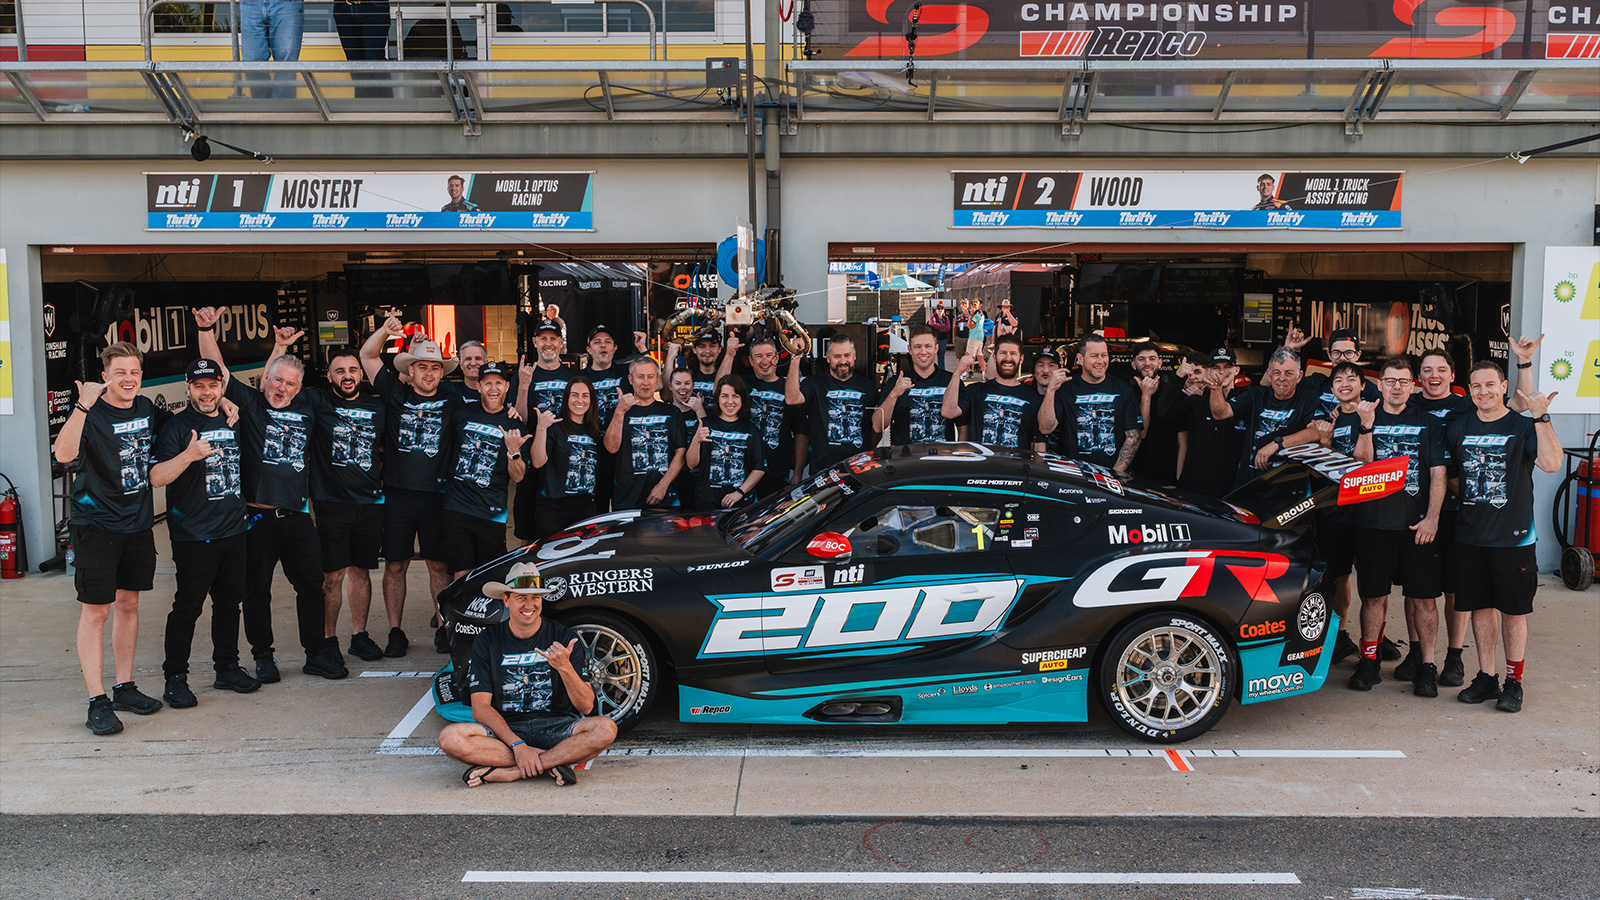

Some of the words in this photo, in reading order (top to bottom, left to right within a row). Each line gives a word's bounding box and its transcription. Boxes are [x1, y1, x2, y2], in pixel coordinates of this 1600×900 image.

[1021, 3, 1297, 22] CHAMPIONSHIP
[1088, 26, 1207, 60] Repco
[495, 180, 522, 192] MOBIL
[524, 180, 529, 192] 1
[532, 180, 559, 192] OPTUS
[961, 175, 1009, 202] nti
[1034, 176, 1055, 205] 2
[1089, 176, 1144, 206] WOOD
[1304, 178, 1331, 191] MOBIL
[1333, 178, 1339, 191] 1
[1341, 178, 1370, 191] TRUCK
[155, 178, 201, 204] nti
[232, 180, 244, 207] 1
[280, 179, 363, 208] MOSTERT
[512, 193, 542, 206] RACING
[1304, 191, 1336, 205] ASSIST
[1336, 191, 1368, 205] RACING
[167, 214, 203, 228] Thrifty
[240, 214, 276, 228] Thrifty
[313, 214, 350, 228] Thrifty
[386, 214, 422, 228] Thrifty
[460, 214, 496, 228] Thrifty
[533, 214, 569, 228] Thrifty
[972, 212, 1009, 226] Thrifty
[1046, 212, 1082, 226] Thrifty
[1120, 212, 1156, 226] Thrifty
[1194, 212, 1230, 226] Thrifty
[1268, 212, 1304, 226] Thrifty
[1341, 212, 1378, 226] Thrifty
[1568, 271, 1578, 280] bp
[1407, 330, 1450, 357] ASSIS
[1564, 349, 1575, 358] bp
[1343, 470, 1404, 488] SUPERCHEAP
[1361, 484, 1383, 493] AUTO
[971, 524, 985, 550] 1
[1107, 523, 1168, 545] Mobil
[825, 541, 846, 551] BOC
[695, 560, 750, 572] DUNLOP
[568, 568, 654, 585] RINGERS
[833, 564, 865, 583] nti
[1073, 549, 1290, 608] GR
[569, 579, 654, 598] WESTERN
[467, 597, 493, 613] NGK
[702, 579, 1026, 654] 200
[1239, 620, 1287, 639] Coates
[1169, 618, 1206, 637] SPORT
[1205, 633, 1229, 663] MAXX
[633, 643, 650, 680] SPORT
[1021, 646, 1087, 665] SUPERCHEAP
[1041, 661, 1065, 670] AUTO
[952, 684, 978, 693] Lloyds
[1248, 671, 1304, 693] move
[633, 680, 650, 714] MAXX
[917, 691, 941, 699] Spicers
[701, 705, 732, 715] Repco
[1110, 692, 1159, 738] DUNLOP
